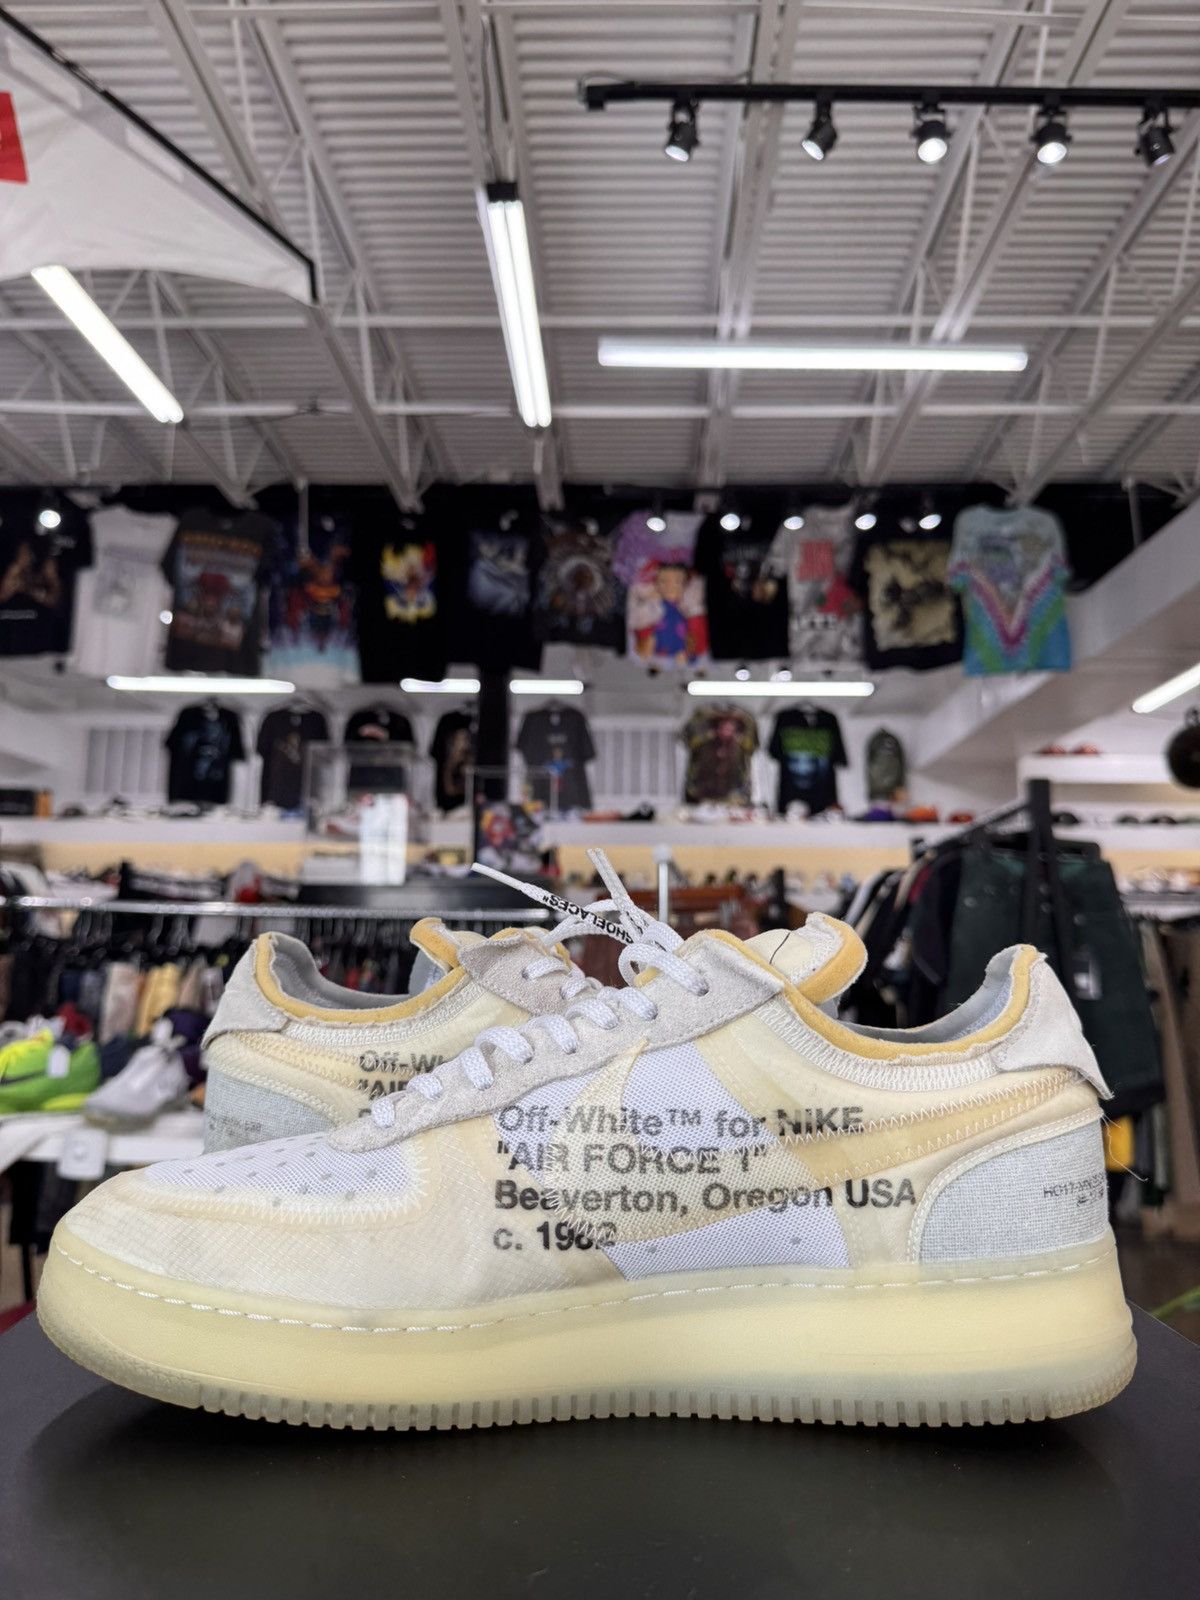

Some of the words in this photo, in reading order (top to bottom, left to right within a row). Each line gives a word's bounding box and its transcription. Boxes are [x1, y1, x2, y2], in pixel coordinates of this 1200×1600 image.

[714, 1109, 767, 1138] for
[776, 1105, 865, 1137] NIKE
[496, 1140, 570, 1172] "AIR
[583, 1142, 720, 1175] FORCE
[494, 1178, 689, 1217] Beaverton,
[701, 1182, 834, 1213] Oregon
[845, 1177, 917, 1209] USA
[492, 1227, 523, 1251] c.
